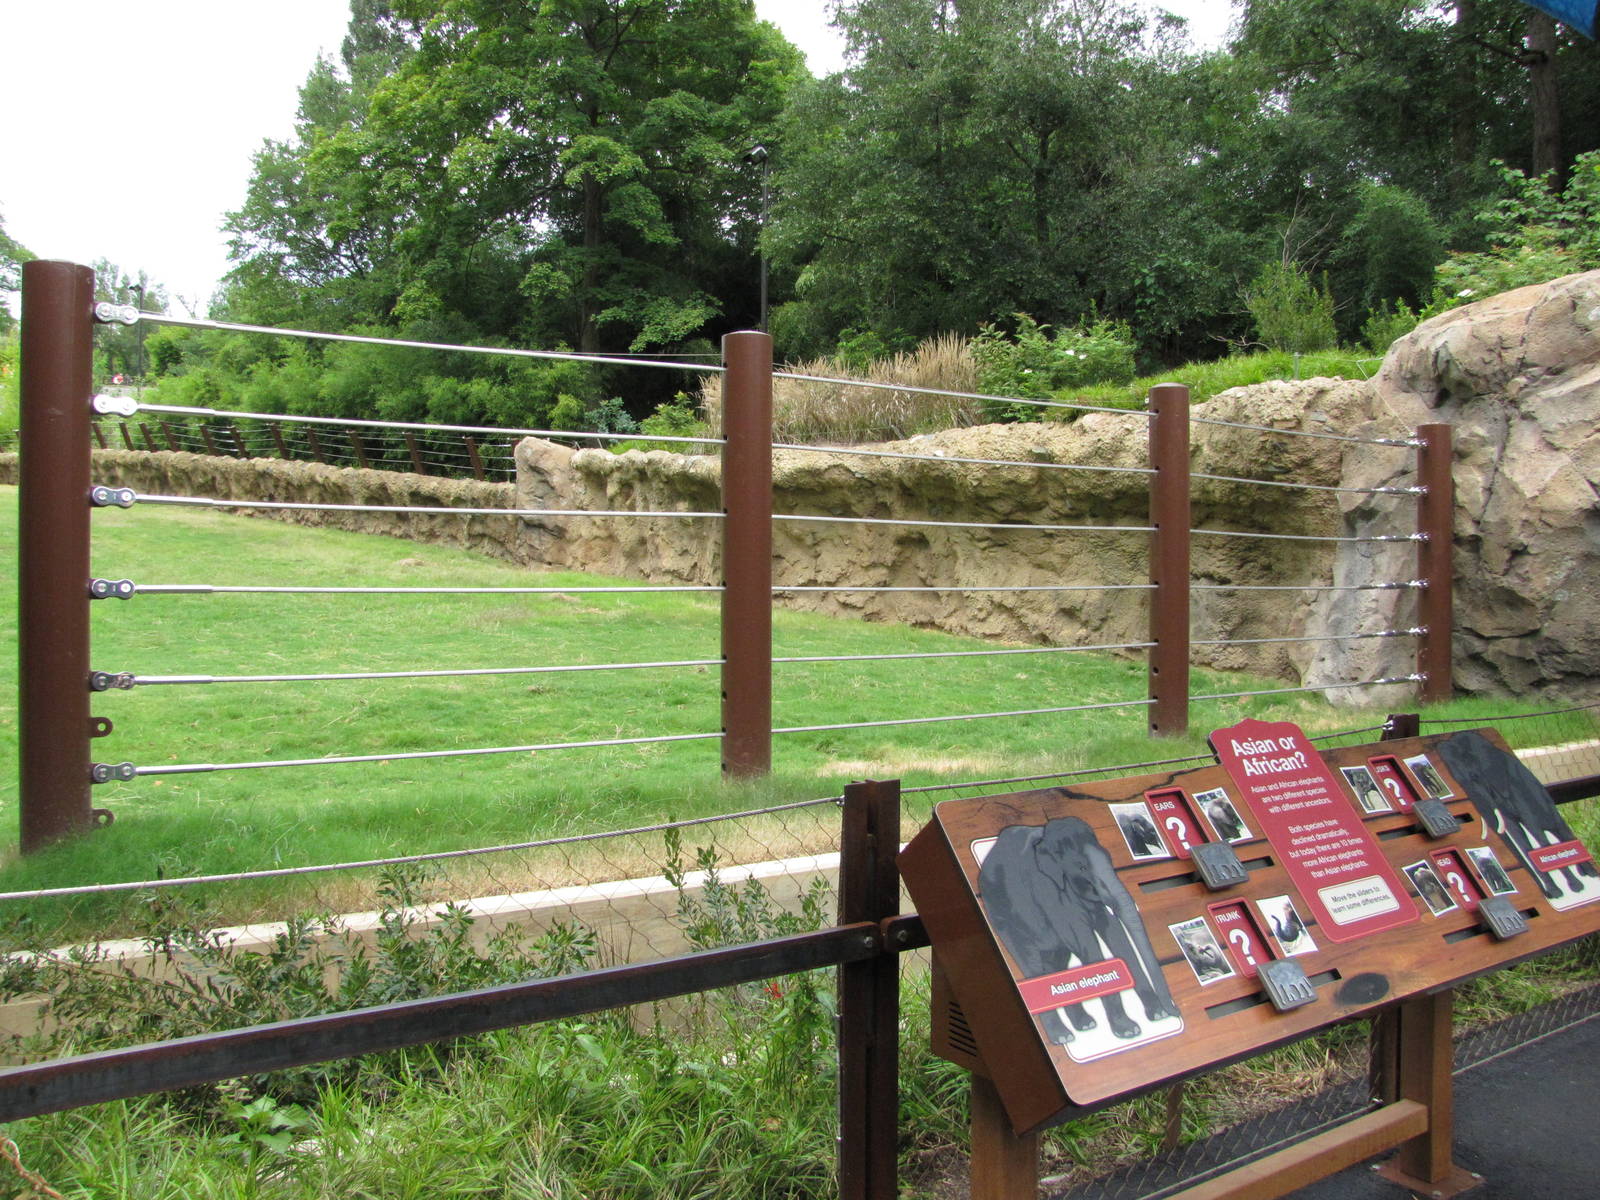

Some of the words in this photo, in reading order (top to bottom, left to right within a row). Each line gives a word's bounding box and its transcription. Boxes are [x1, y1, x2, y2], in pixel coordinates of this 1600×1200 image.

[1231, 737, 1278, 756] Asian
[1279, 736, 1296, 751] or
[1243, 751, 1308, 776] African?
[1298, 776, 1324, 786] elephants
[1283, 790, 1305, 800] different
[1306, 787, 1326, 796] species
[1154, 802, 1176, 811] EARS
[1282, 802, 1305, 811] different
[1305, 798, 1332, 807] ancestors.
[1288, 825, 1303, 834] Both
[1303, 822, 1324, 831] species
[1292, 834, 1316, 845] declined
[1288, 850, 1300, 858] but
[1316, 844, 1331, 852] there
[1318, 855, 1338, 864] African
[1338, 848, 1364, 860] elephants
[1539, 855, 1557, 863] African
[1557, 848, 1578, 858] elephant
[1311, 870, 1325, 878] than
[1325, 867, 1341, 875] Asian
[1341, 861, 1368, 871] elephants.
[1357, 888, 1374, 897] sliders
[1346, 902, 1361, 910] some
[1361, 895, 1390, 906] differences.
[1215, 910, 1241, 923] TRUNK
[1050, 983, 1078, 996] Asian
[1079, 970, 1120, 988] elephant
